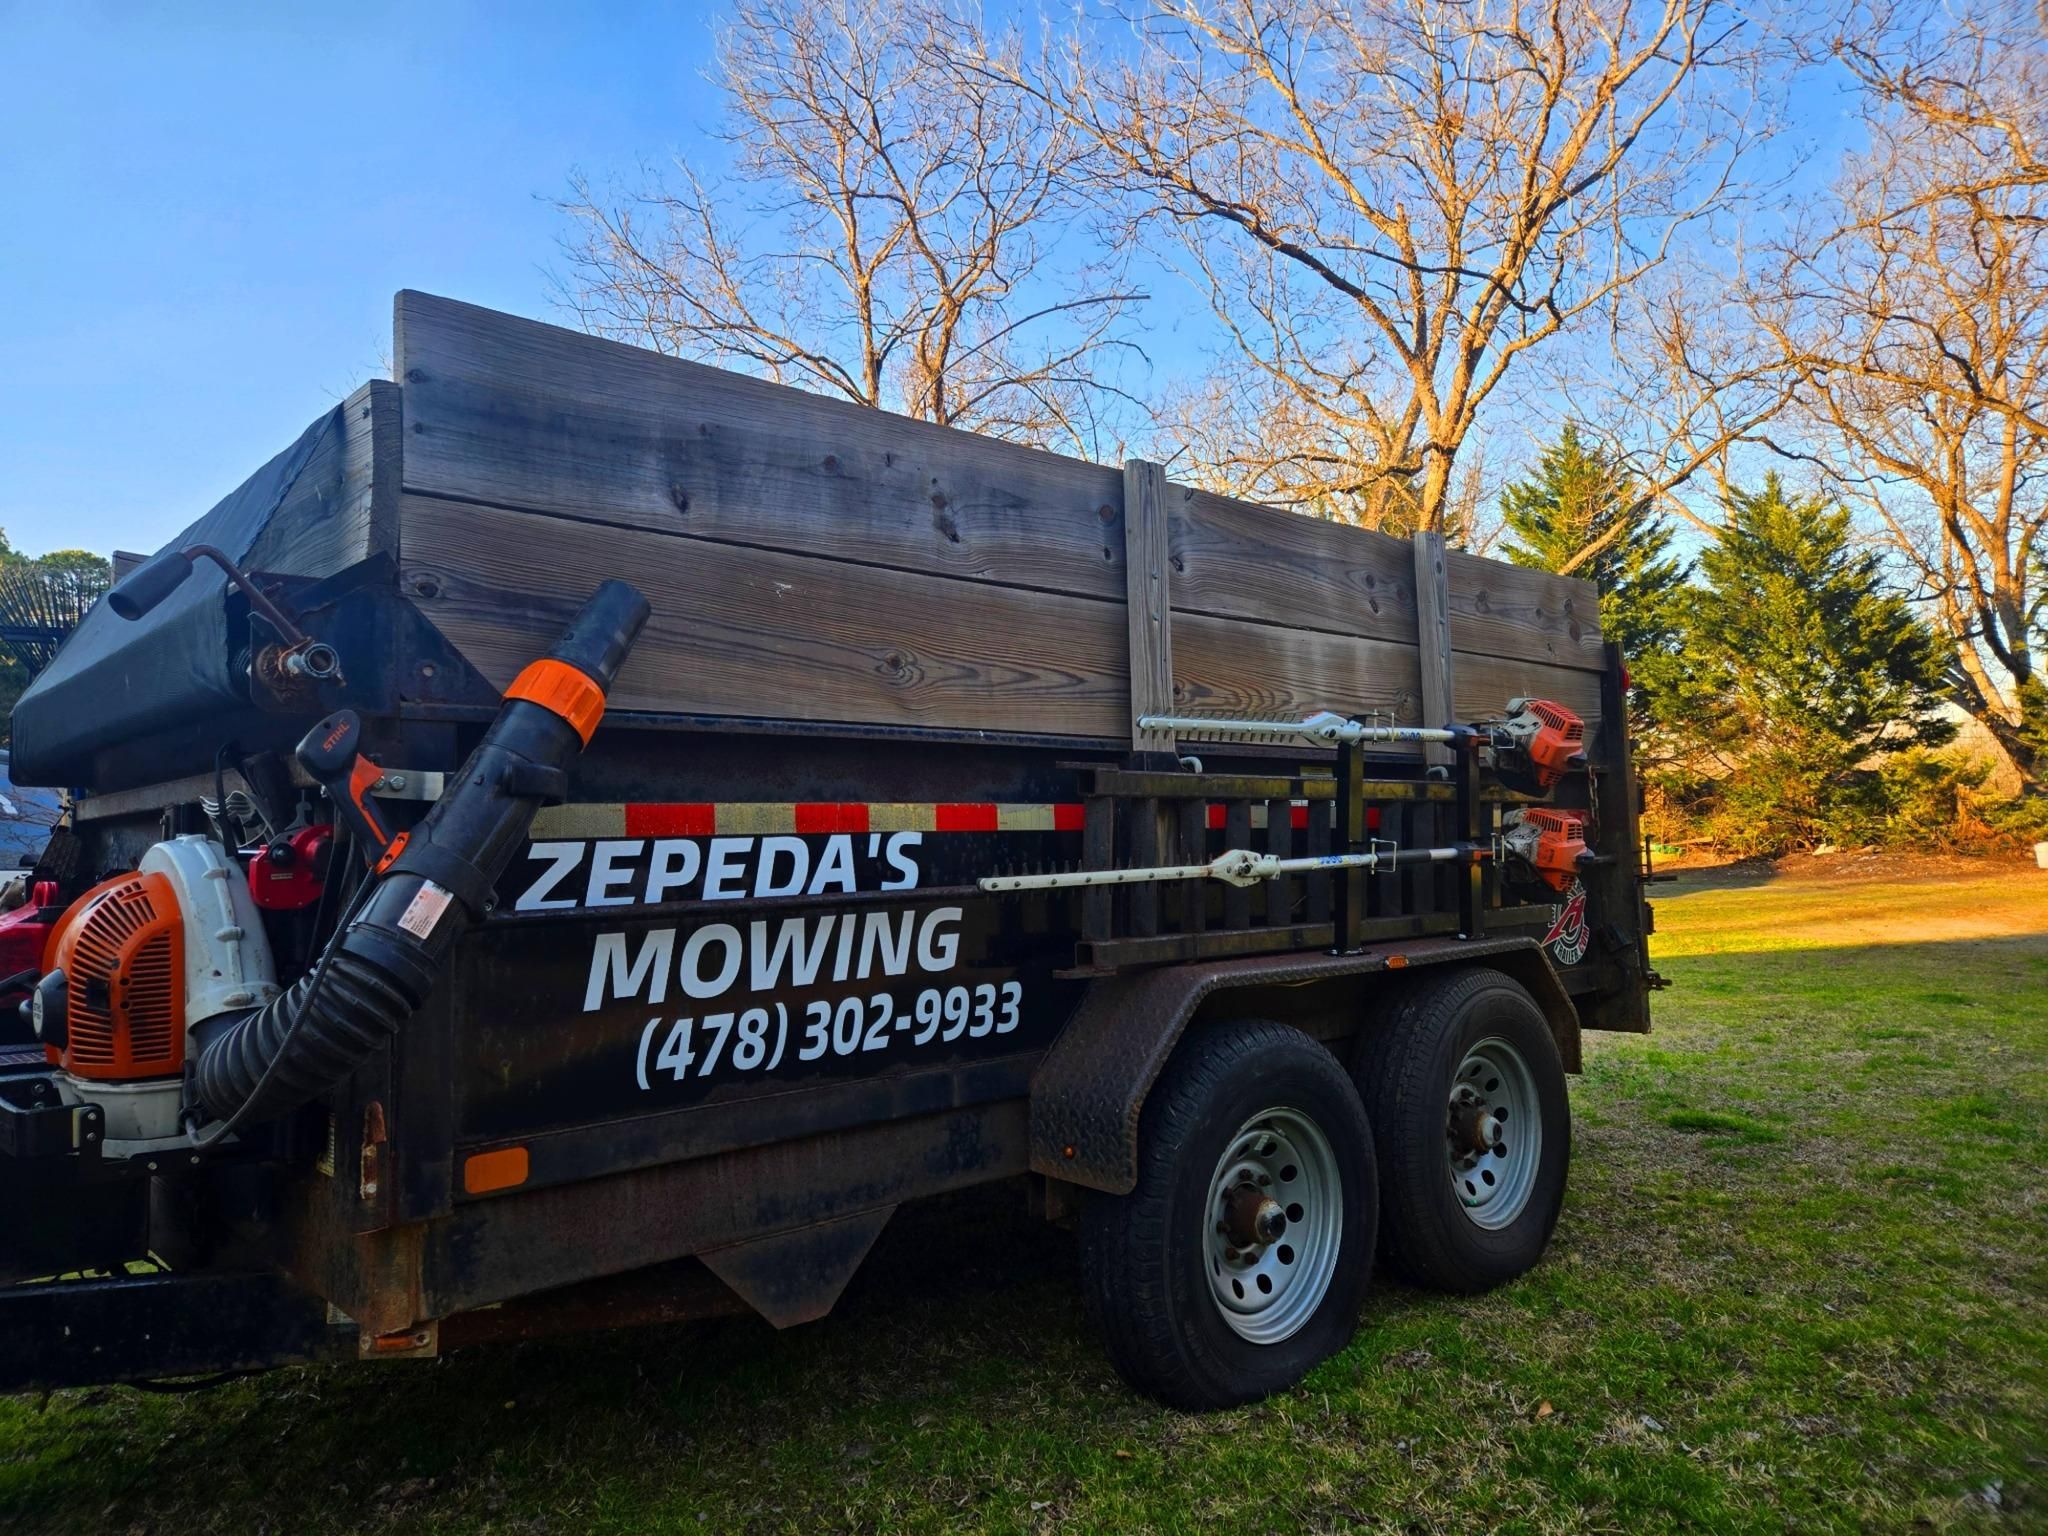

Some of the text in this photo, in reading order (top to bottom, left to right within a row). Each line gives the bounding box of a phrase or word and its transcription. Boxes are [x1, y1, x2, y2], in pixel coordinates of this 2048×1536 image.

[323, 721, 349, 752] STIHL
[515, 832, 922, 911] ZEPEDA'S
[583, 907, 963, 1012] MOWING
[636, 981, 1022, 1090] (478) 302-9933
